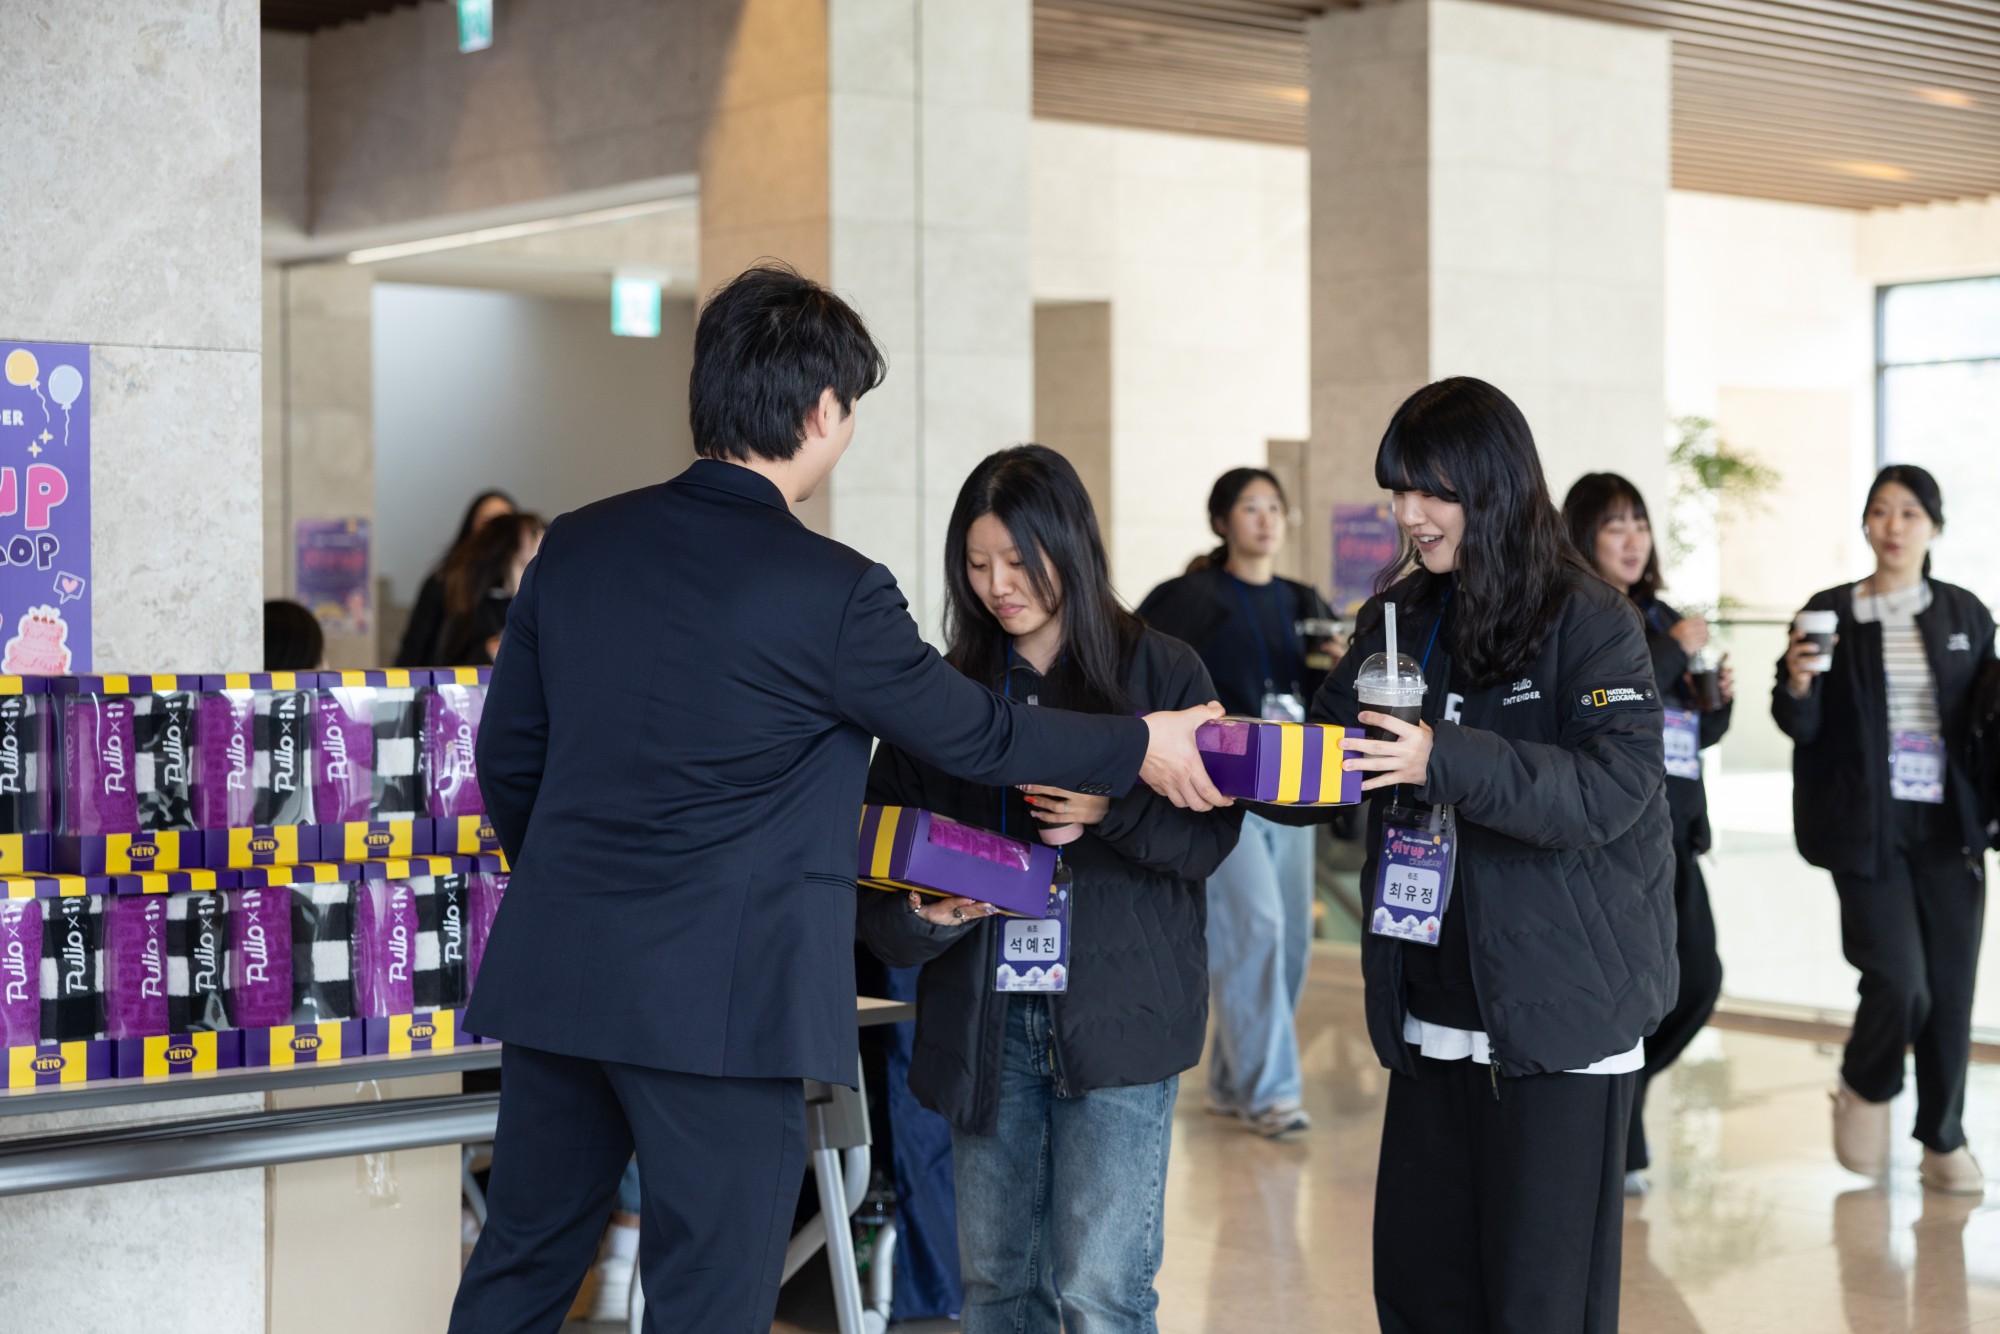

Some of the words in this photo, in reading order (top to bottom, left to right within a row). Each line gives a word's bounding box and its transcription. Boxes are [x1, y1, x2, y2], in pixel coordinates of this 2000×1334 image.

[1606, 688, 1636, 696] NATIONAL
[1607, 694, 1645, 703] GEOGRAPHIC
[0, 734, 21, 795] Pulio
[103, 735, 126, 795] Pulio
[163, 726, 183, 786] Pulio
[227, 733, 246, 792] Pulio
[274, 735, 296, 793] Pulio
[322, 726, 349, 783] Pulio
[392, 886, 408, 909] iN
[62, 931, 88, 995] Pulio
[194, 932, 217, 994] Pulio
[242, 925, 269, 986] Pulio
[389, 926, 407, 984] Pulio
[443, 905, 463, 964] Pulio
[2, 941, 29, 1005] Pulio
[141, 938, 163, 999] Pulio
